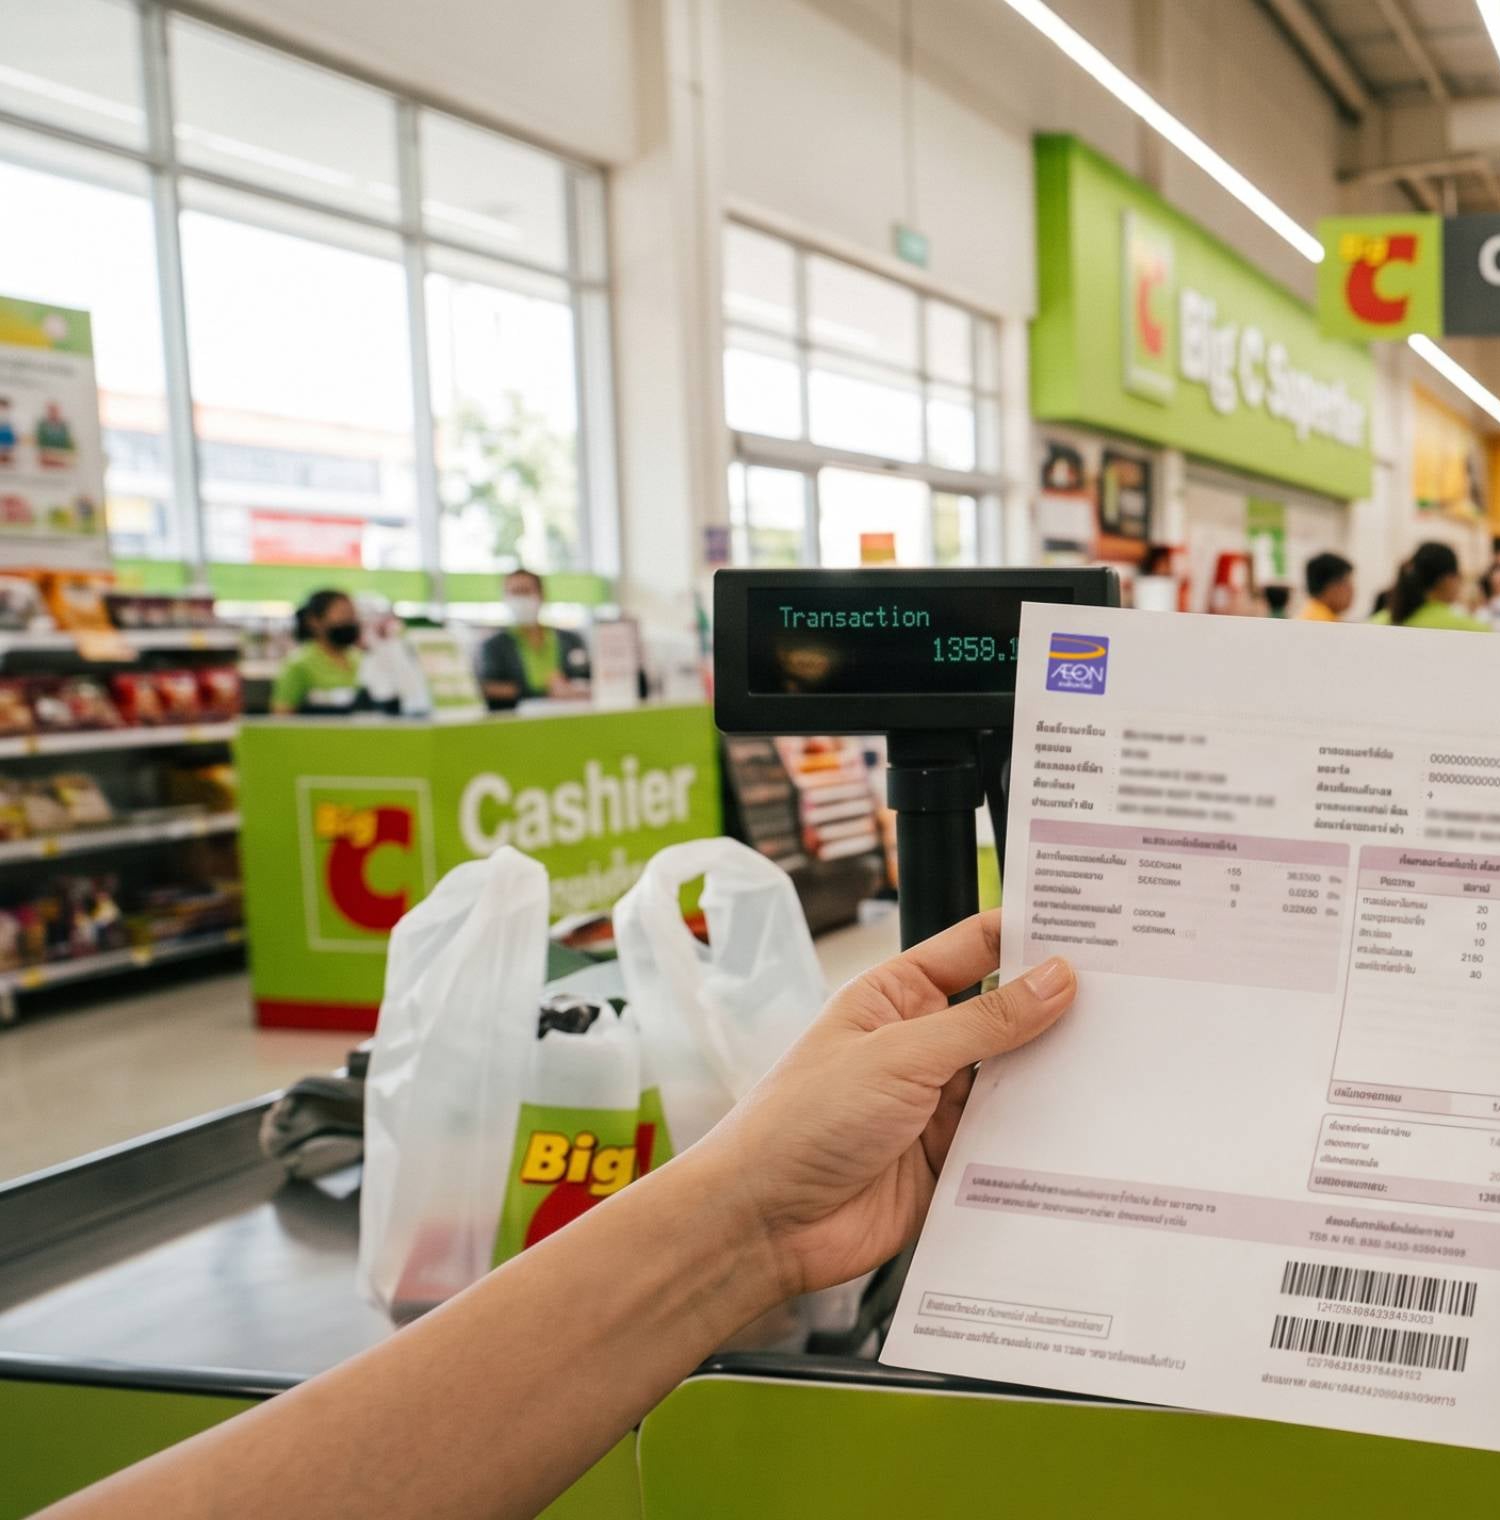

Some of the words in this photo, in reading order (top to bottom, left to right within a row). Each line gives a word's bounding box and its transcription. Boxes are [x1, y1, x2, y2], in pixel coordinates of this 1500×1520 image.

[779, 606, 930, 628] Transaction
[459, 755, 698, 857] Cashier
[520, 1131, 638, 1198] Big
